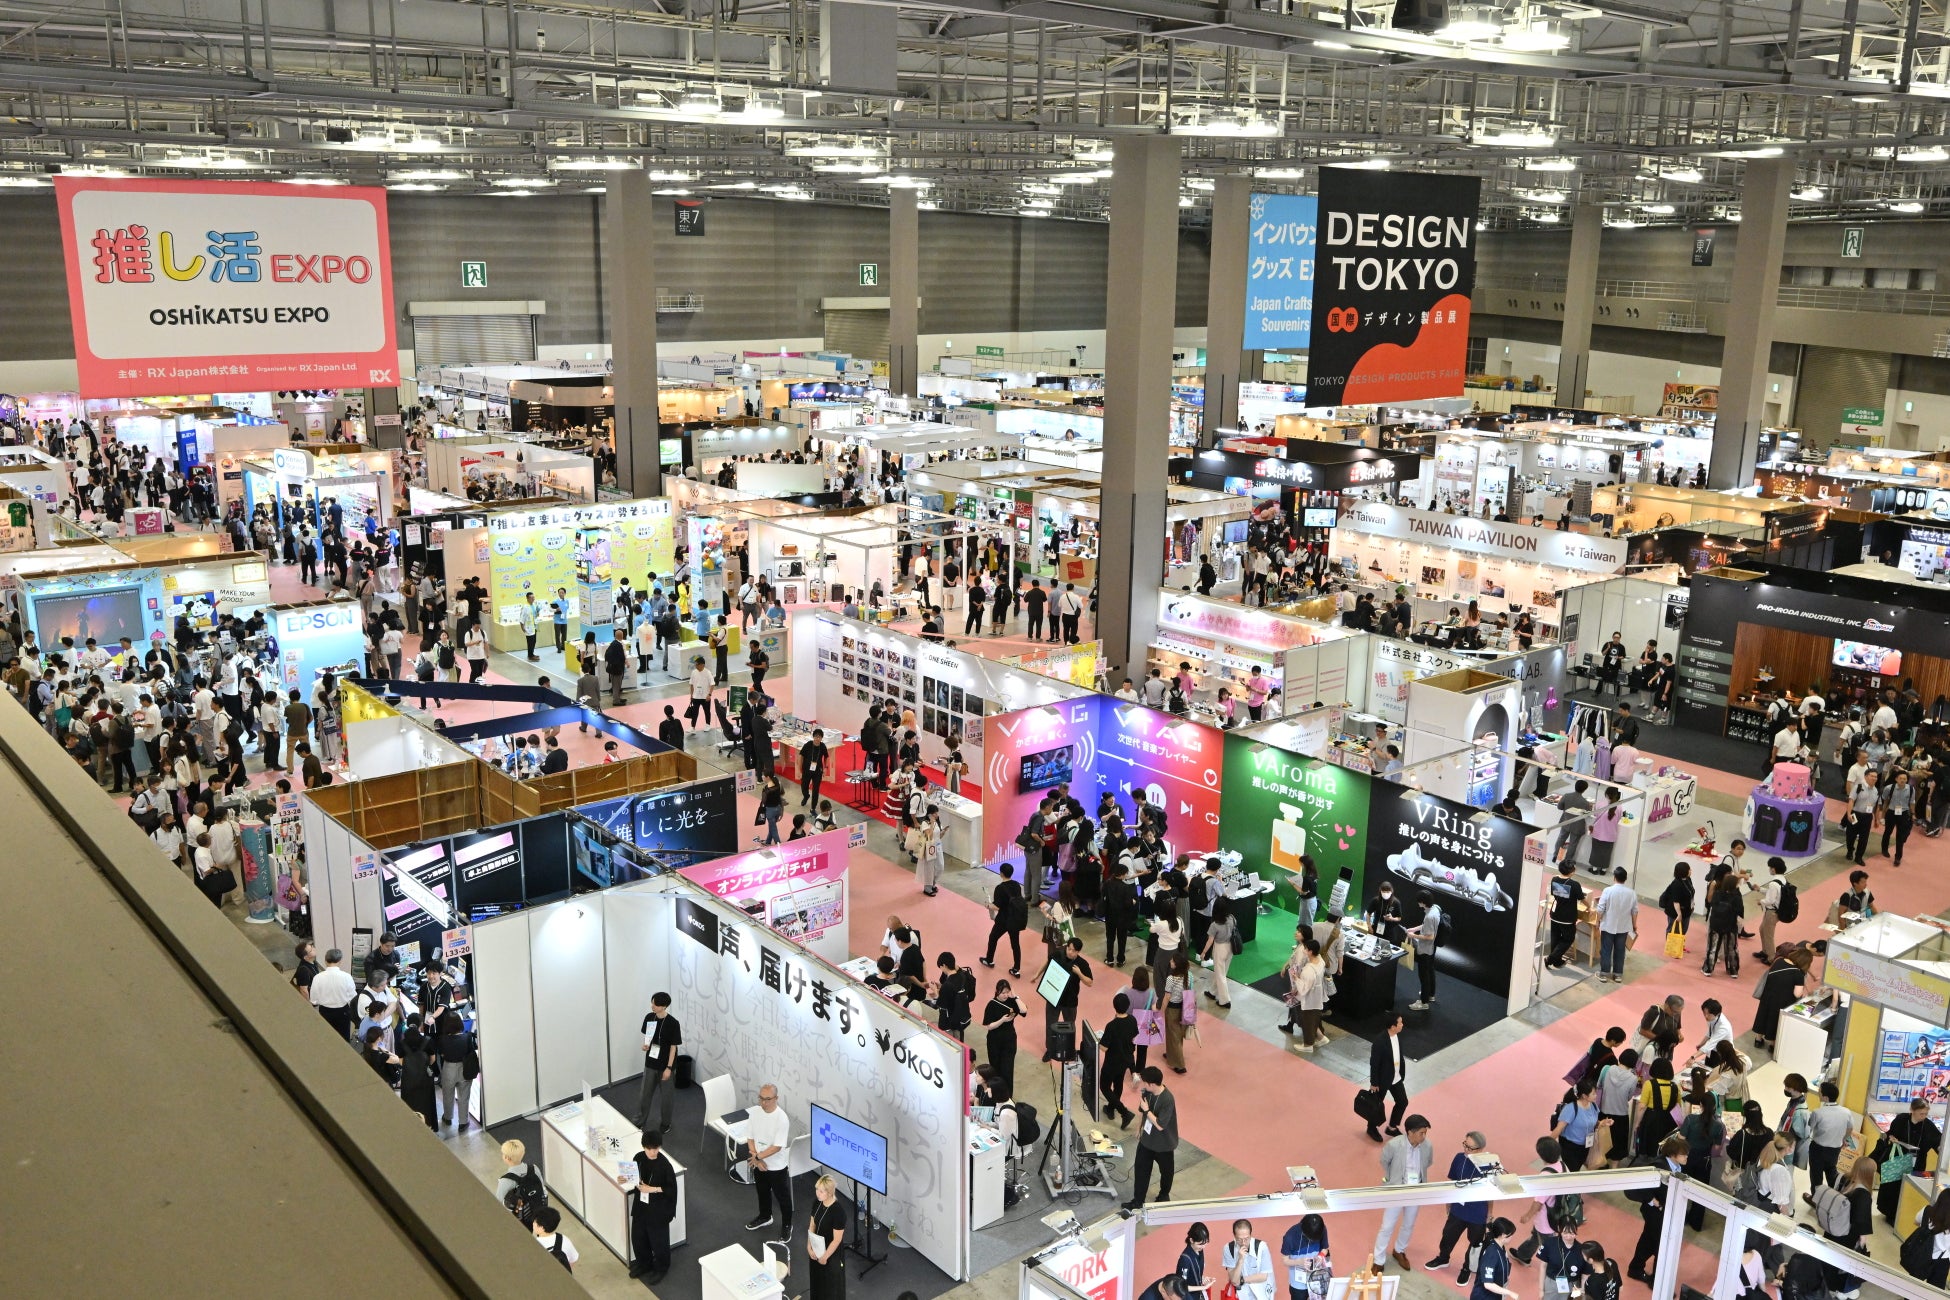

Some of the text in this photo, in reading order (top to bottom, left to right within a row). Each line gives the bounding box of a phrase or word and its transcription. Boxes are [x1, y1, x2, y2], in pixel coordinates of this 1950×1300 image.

[1326, 211, 1470, 248] DESIGN
[91, 224, 372, 284] 推し活 EXPO
[1251, 257, 1293, 281] グッズ
[1332, 256, 1459, 290] TOKYO
[1250, 296, 1312, 313] Japan Crafts
[274, 306, 330, 324] EXPO
[1261, 316, 1310, 332] Souvenirs
[1330, 312, 1355, 327] 国際
[147, 367, 166, 379] RX
[299, 363, 311, 372] RX
[312, 362, 340, 373] Japan
[370, 368, 392, 383] RX
[1313, 375, 1345, 386] TOKYO
[1348, 373, 1384, 385] DESIGN
[1388, 370, 1436, 383] PRODUCTS
[1356, 510, 1386, 526] Taiwan
[1408, 518, 1538, 552] TAIWAN PAVILION
[1578, 546, 1616, 564] Taiwan
[1756, 603, 1800, 616] PRO-IRODA
[287, 609, 353, 633] EPSON
[928, 655, 959, 669] ONE SHEEN
[1382, 644, 1421, 663] 株式会社
[1496, 662, 1543, 681] UB-LAB.
[1117, 732, 1197, 765] 次世代 音楽プレイヤー
[1253, 751, 1338, 795] VAroma
[1252, 775, 1335, 811] 推しの声が香り出す
[1414, 799, 1494, 850] VRing
[1398, 823, 1505, 868] 推しの声を身につける
[1524, 854, 1545, 865] L34-20
[355, 869, 378, 880] L33-24
[445, 946, 470, 958] L33-20
[718, 920, 867, 1049] 声、届けます。
